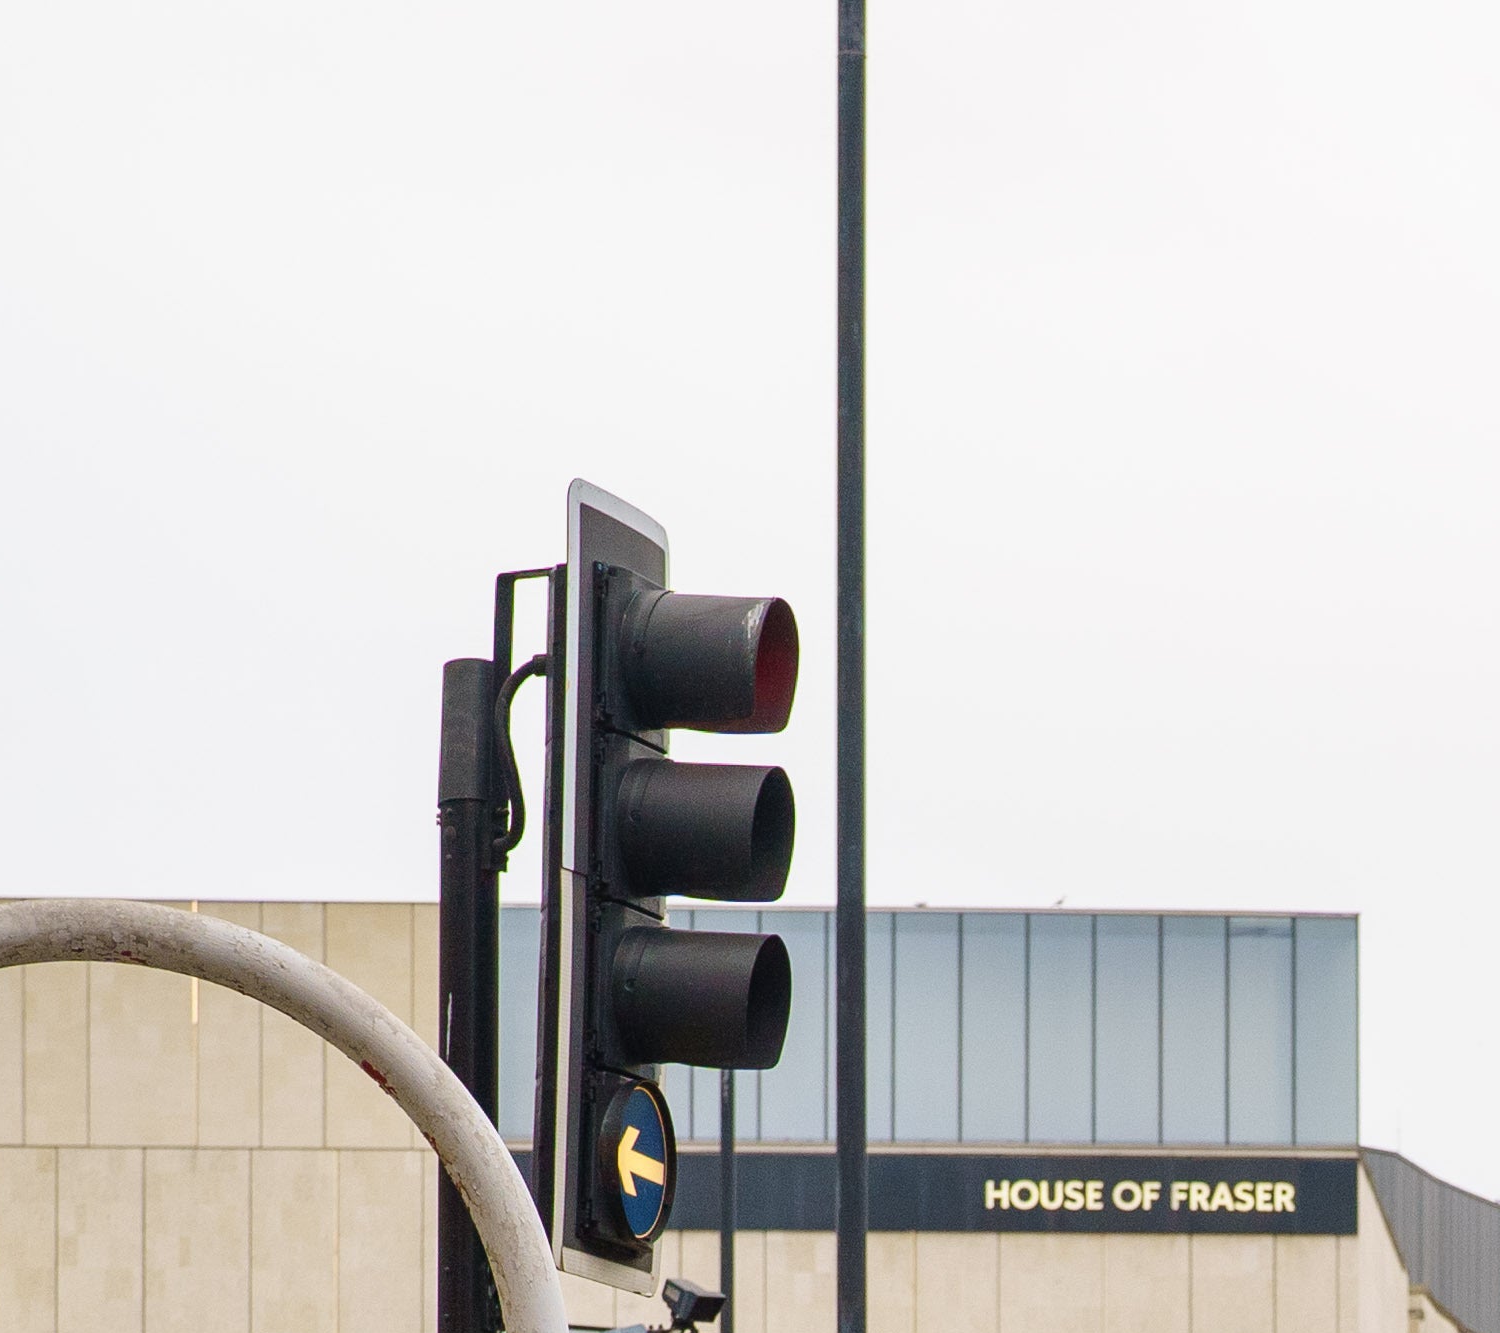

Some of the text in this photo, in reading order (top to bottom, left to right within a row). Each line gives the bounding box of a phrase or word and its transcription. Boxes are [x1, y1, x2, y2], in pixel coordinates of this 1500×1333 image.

[984, 1179, 1296, 1212] HOUSE OF FRASER
